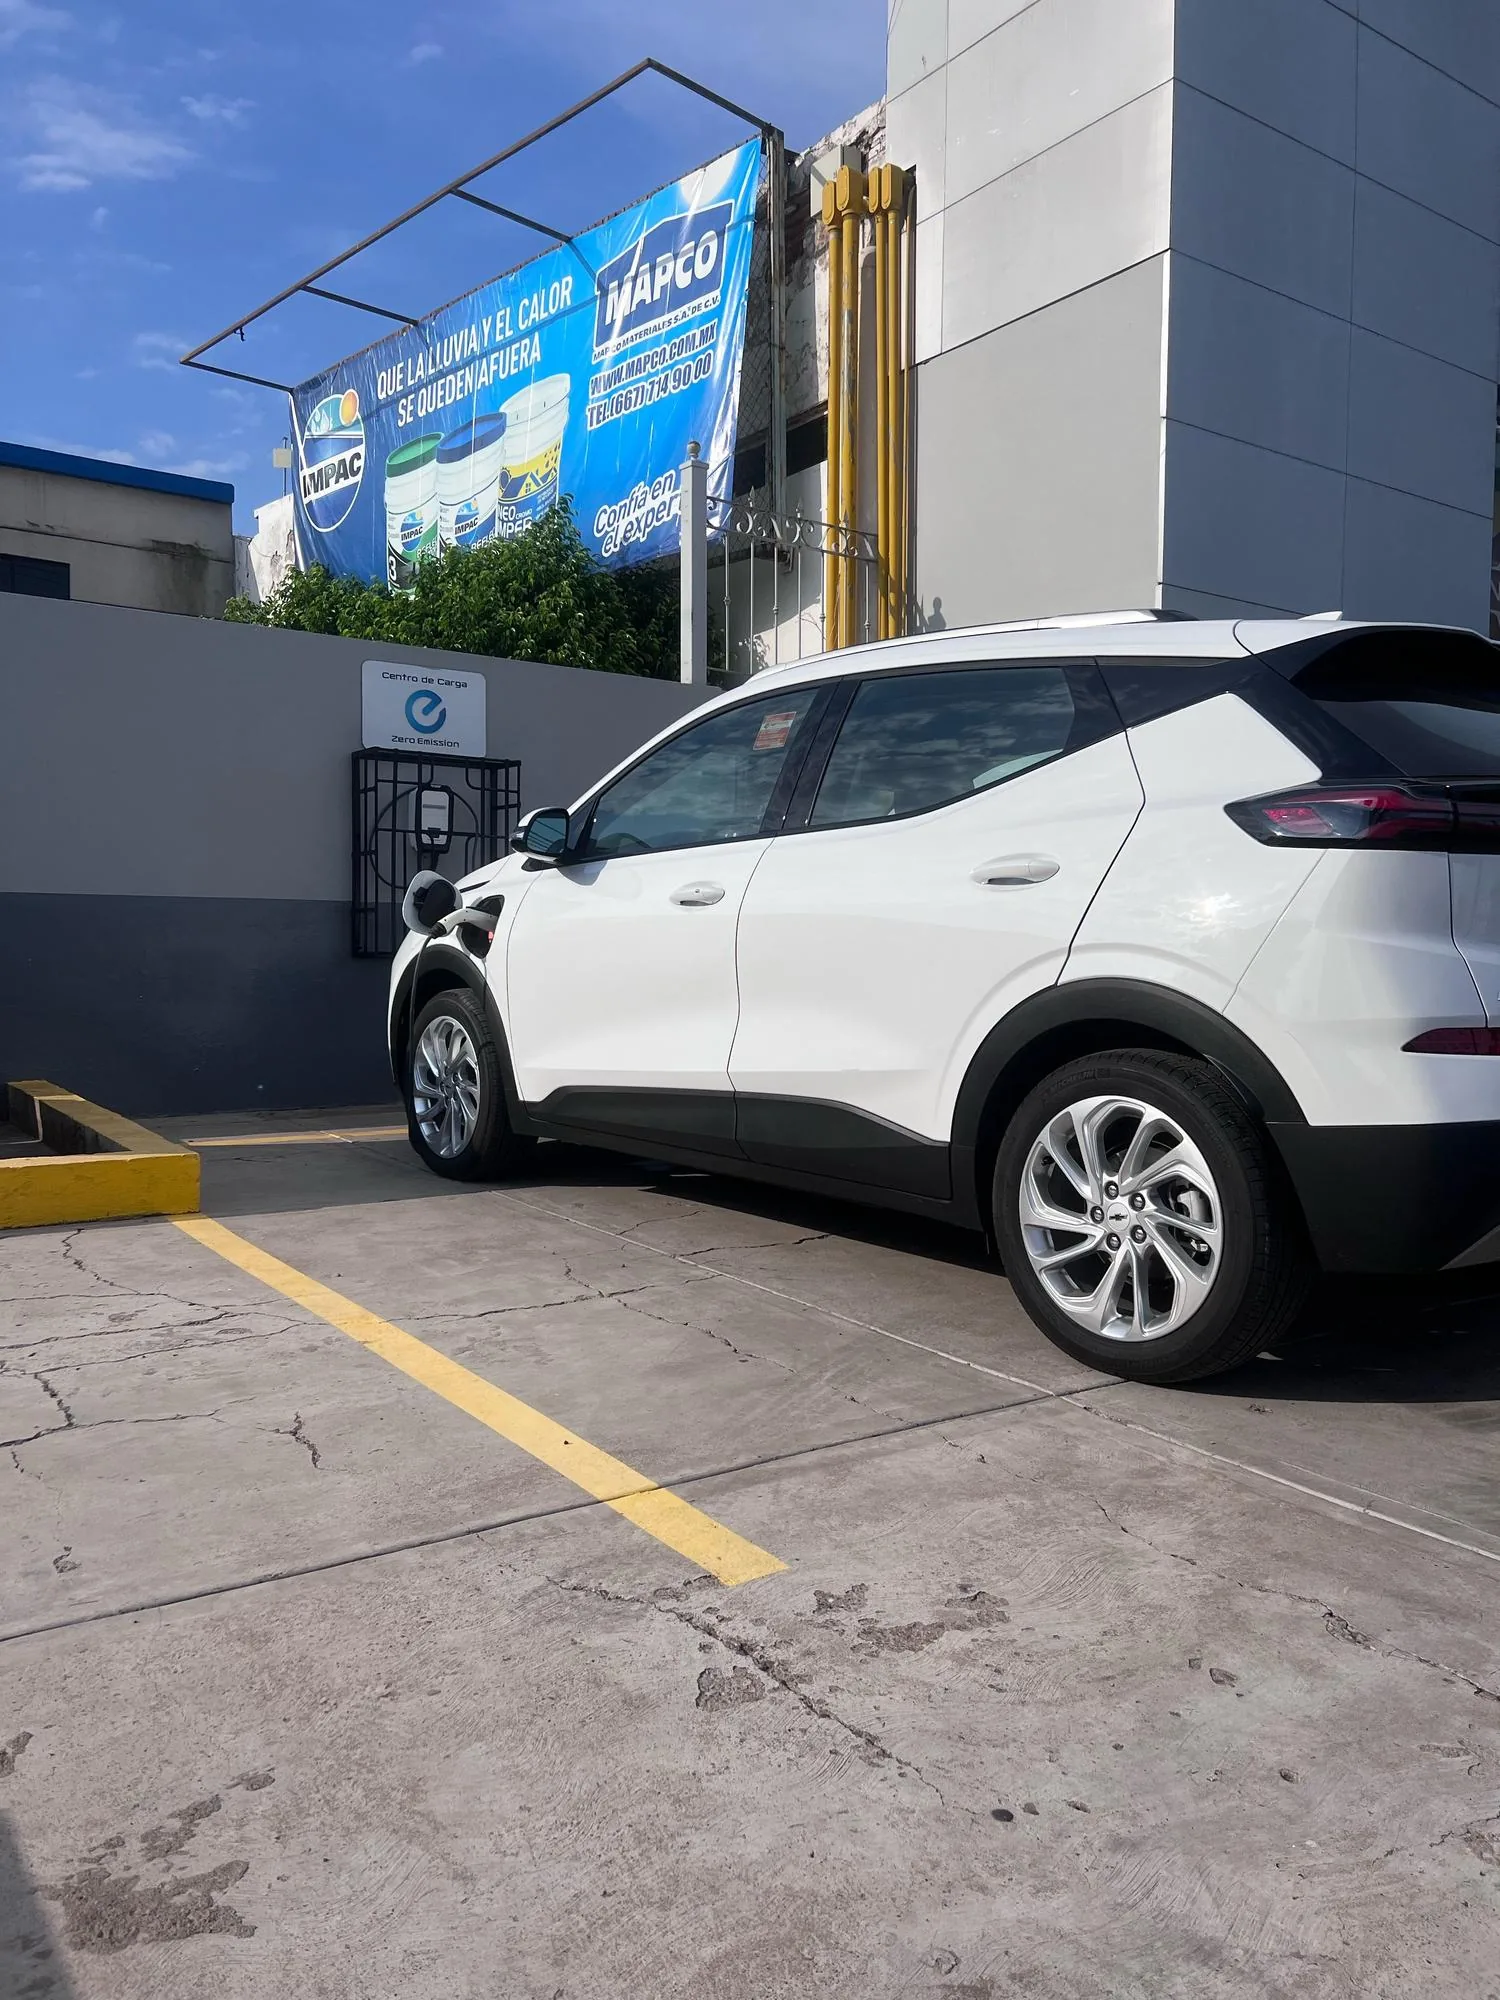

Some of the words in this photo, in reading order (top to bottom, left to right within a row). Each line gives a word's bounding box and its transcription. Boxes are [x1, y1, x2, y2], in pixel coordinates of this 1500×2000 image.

[604, 230, 718, 326] MAPCO
[377, 362, 404, 400] QUE
[407, 353, 425, 386] LA
[428, 324, 478, 375] LLUVIA
[482, 316, 492, 348] Y
[495, 307, 513, 343] EL
[518, 275, 573, 331] CALOR
[622, 318, 672, 348] MATERIALES
[691, 302, 702, 315] DE
[704, 295, 720, 309] C.V.
[397, 392, 415, 427] SE
[417, 363, 475, 418] QUEDEN
[477, 332, 541, 390] AFUERA
[591, 322, 717, 396] WWW.MAPCO.COM.MX
[647, 371, 669, 402] 714
[672, 363, 691, 390] 90
[694, 352, 712, 378] 00
[303, 452, 362, 498] IMPAC
[455, 517, 478, 535] IMPAC
[595, 482, 648, 535] Confía
[651, 472, 674, 500] en
[603, 525, 618, 554] el
[622, 495, 681, 542] exper
[401, 526, 423, 541] IMPAC
[381, 671, 418, 682] Centro
[421, 676, 434, 684] de
[437, 678, 468, 689] Carga
[391, 735, 415, 744] Zero
[417, 738, 460, 748] Emission
